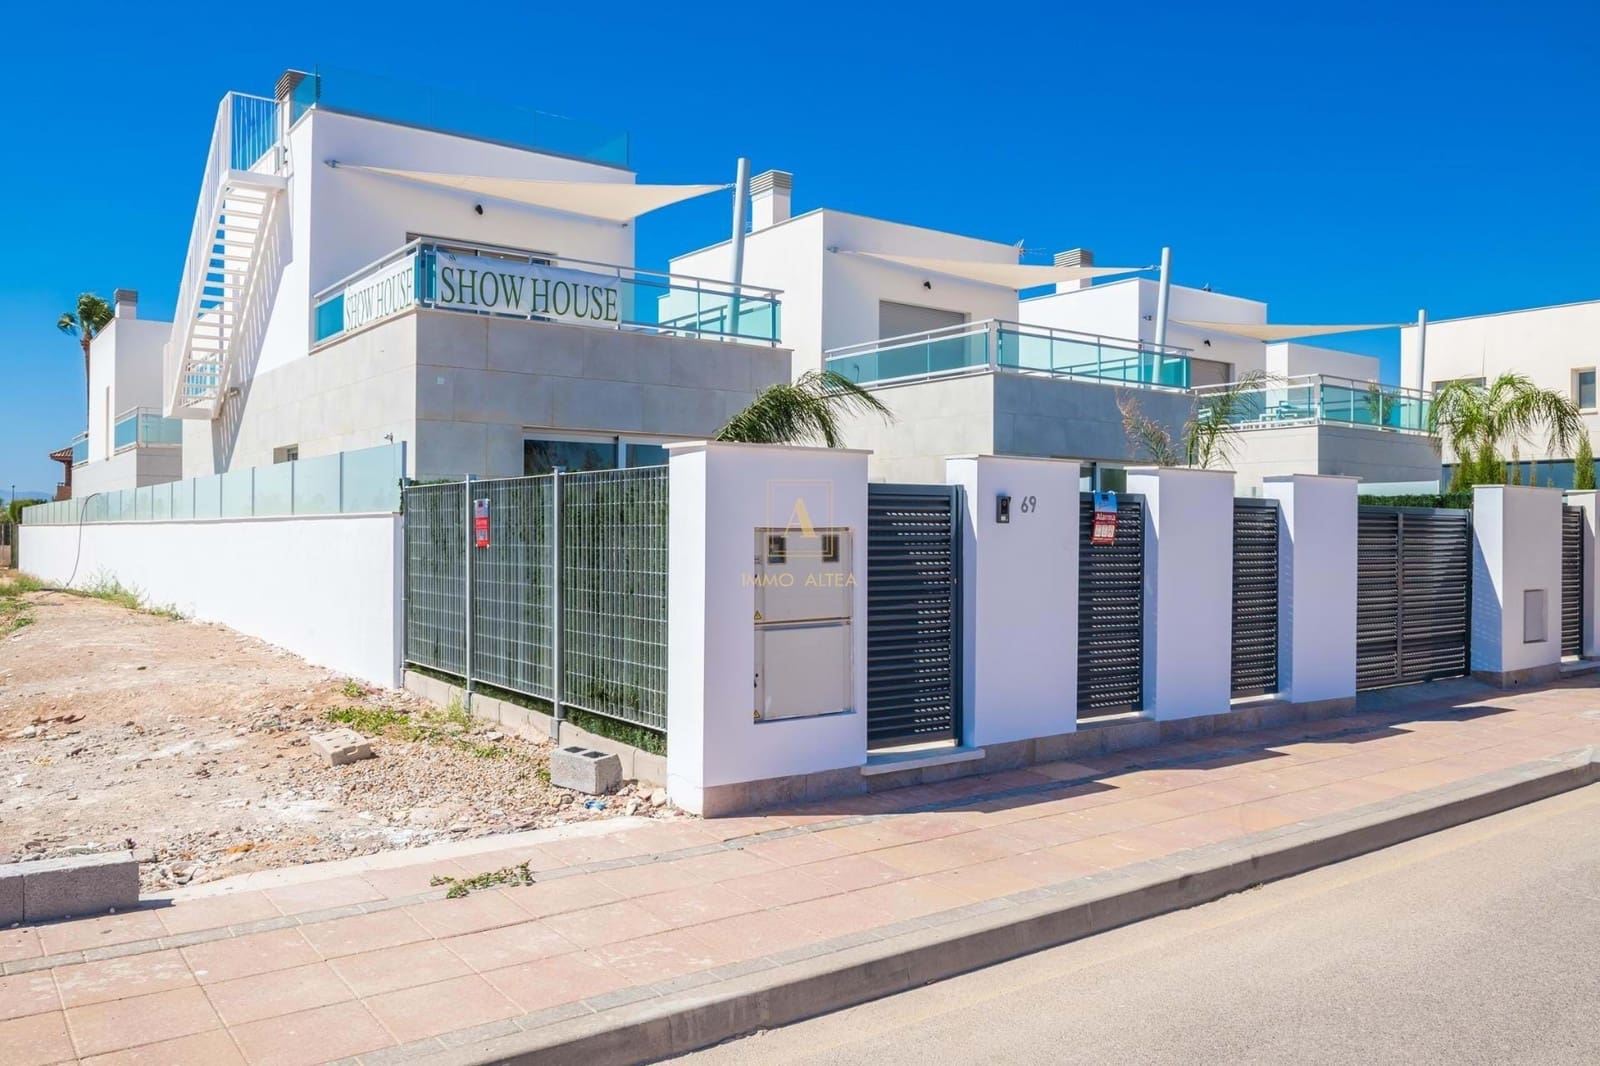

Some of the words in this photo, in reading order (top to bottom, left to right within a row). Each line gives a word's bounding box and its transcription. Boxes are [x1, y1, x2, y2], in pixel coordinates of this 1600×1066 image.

[346, 284, 374, 331] SHOW
[375, 267, 413, 319] HOUSE
[441, 266, 525, 310] SHOW
[530, 278, 618, 322] HOUSE
[1021, 496, 1036, 513] 69
